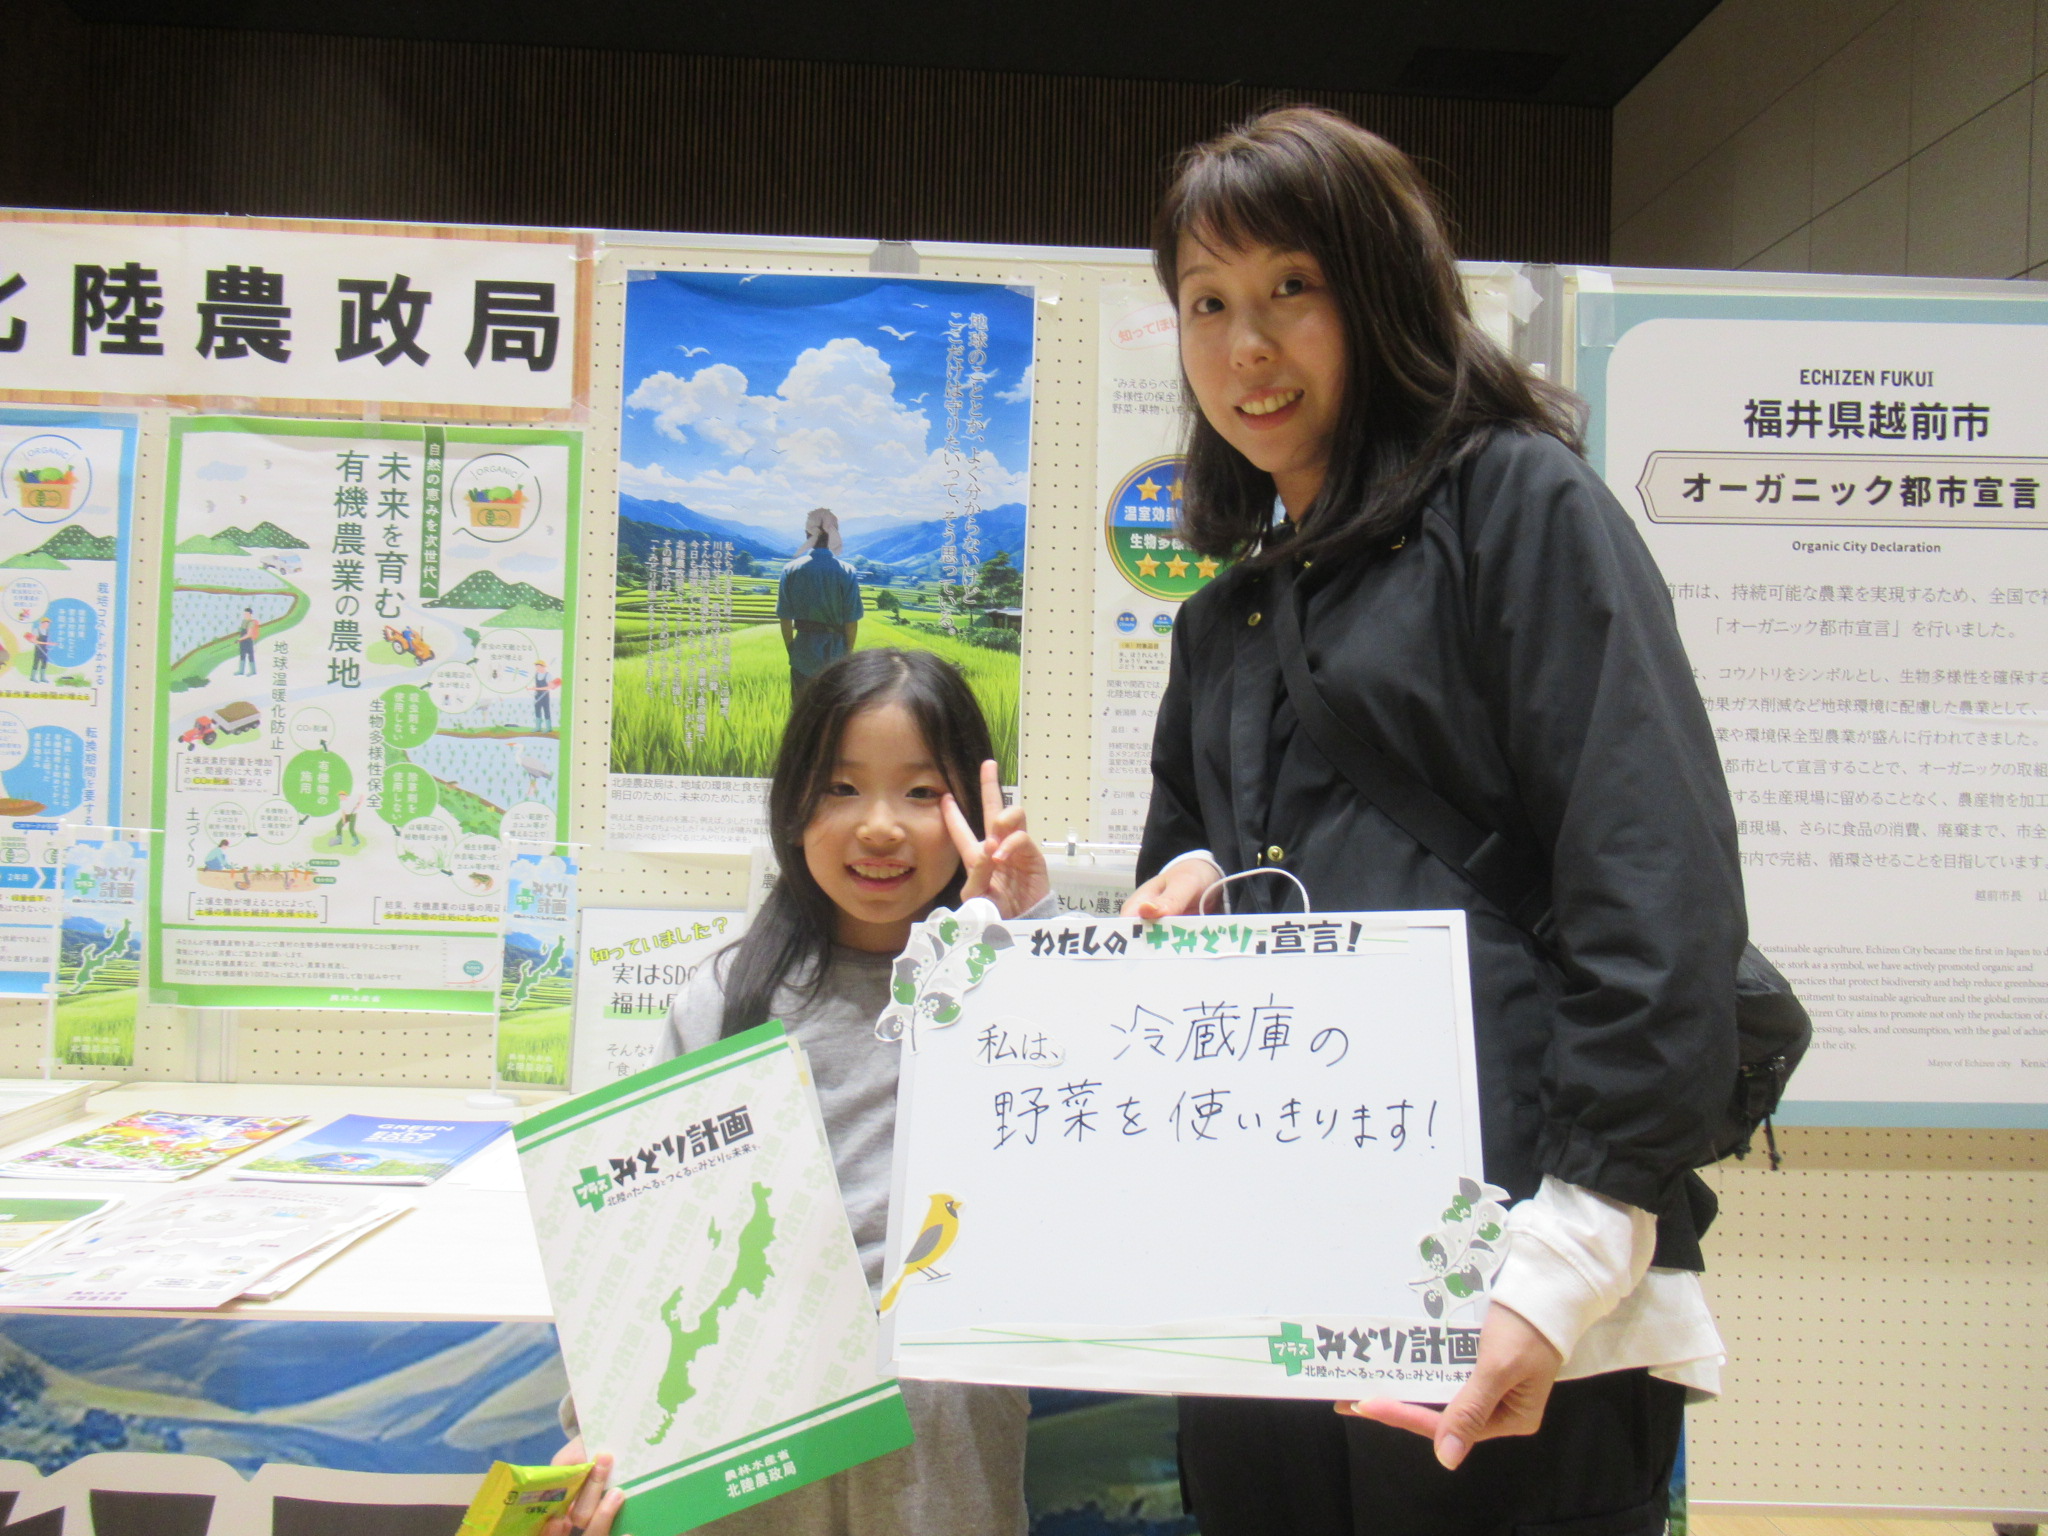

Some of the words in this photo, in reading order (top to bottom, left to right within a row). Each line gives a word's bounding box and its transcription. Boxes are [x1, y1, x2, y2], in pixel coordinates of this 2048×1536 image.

[1800, 369, 1875, 386] ECHIZEN
[1881, 371, 1934, 387] FUKUI
[1744, 399, 1991, 442] 福井県越前市
[422, 442, 442, 591] 自然の恵みを次世代へ
[1682, 472, 2040, 509] オーガニック都市宣言
[328, 448, 370, 689] 有機農業の農地
[375, 450, 412, 619] 未来を育む
[1791, 540, 1840, 554] Organic
[1843, 541, 1867, 555] City
[1870, 541, 1941, 554] Declaration
[270, 640, 289, 751] 地球温暖化防止
[367, 698, 386, 808] 生物多様性保全
[186, 807, 200, 869] 土づくり
[977, 1023, 1061, 1065] 私は、
[1109, 993, 1349, 1068] 冷蔵庫の
[577, 1179, 609, 1201] プラス
[608, 1105, 754, 1187] みどり計画
[1273, 1342, 1309, 1357] プラス
